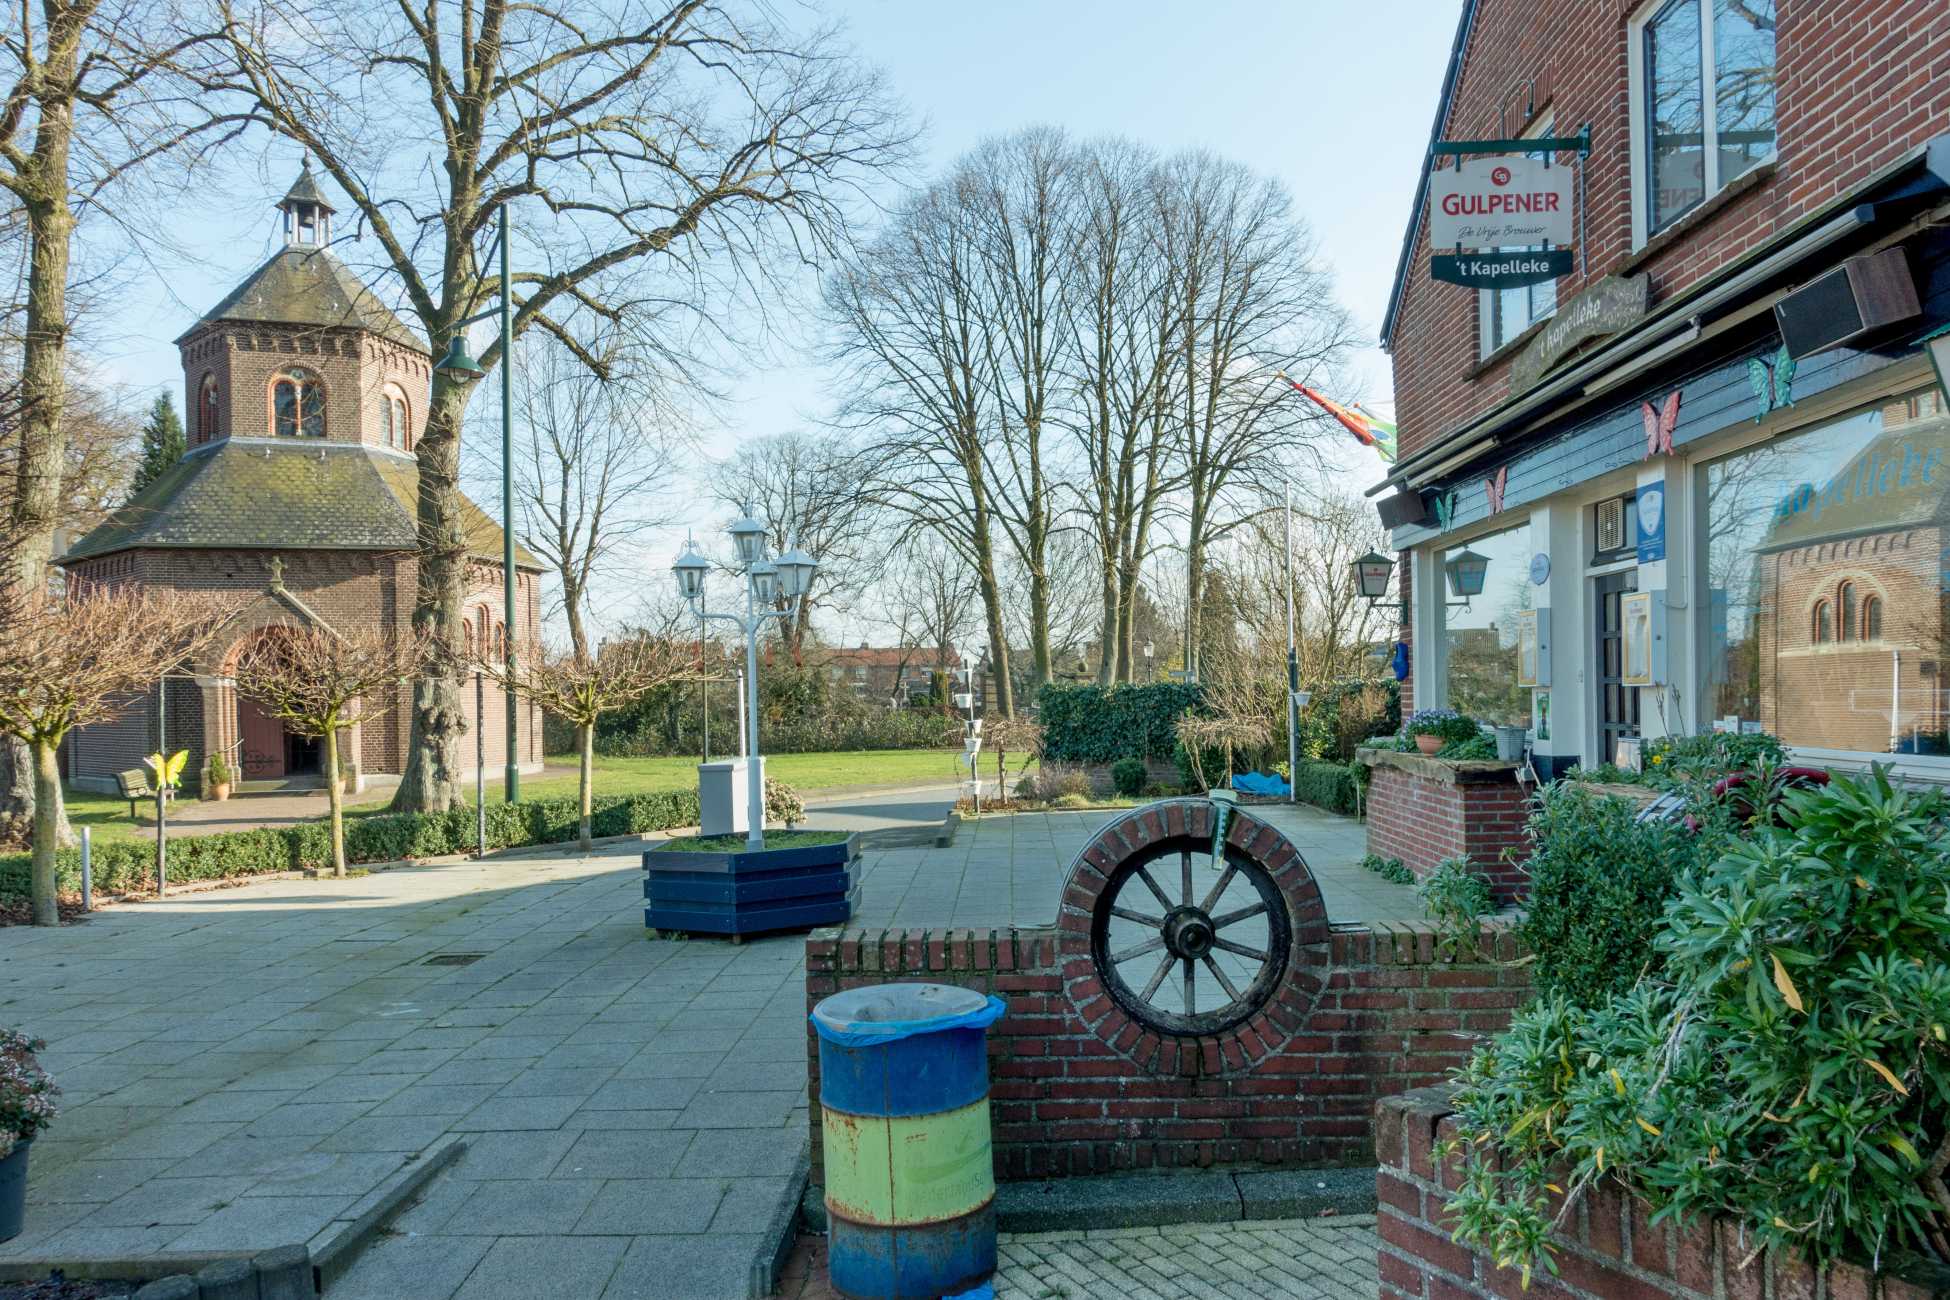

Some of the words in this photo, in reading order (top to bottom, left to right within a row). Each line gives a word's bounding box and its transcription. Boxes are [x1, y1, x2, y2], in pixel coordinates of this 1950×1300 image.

[1441, 192, 1560, 216] GULPENER
[1457, 226, 1475, 240] De
[1476, 225, 1501, 242] Vrije
[1503, 224, 1547, 237] Brouwer
[1471, 259, 1550, 278] Kapelleke
